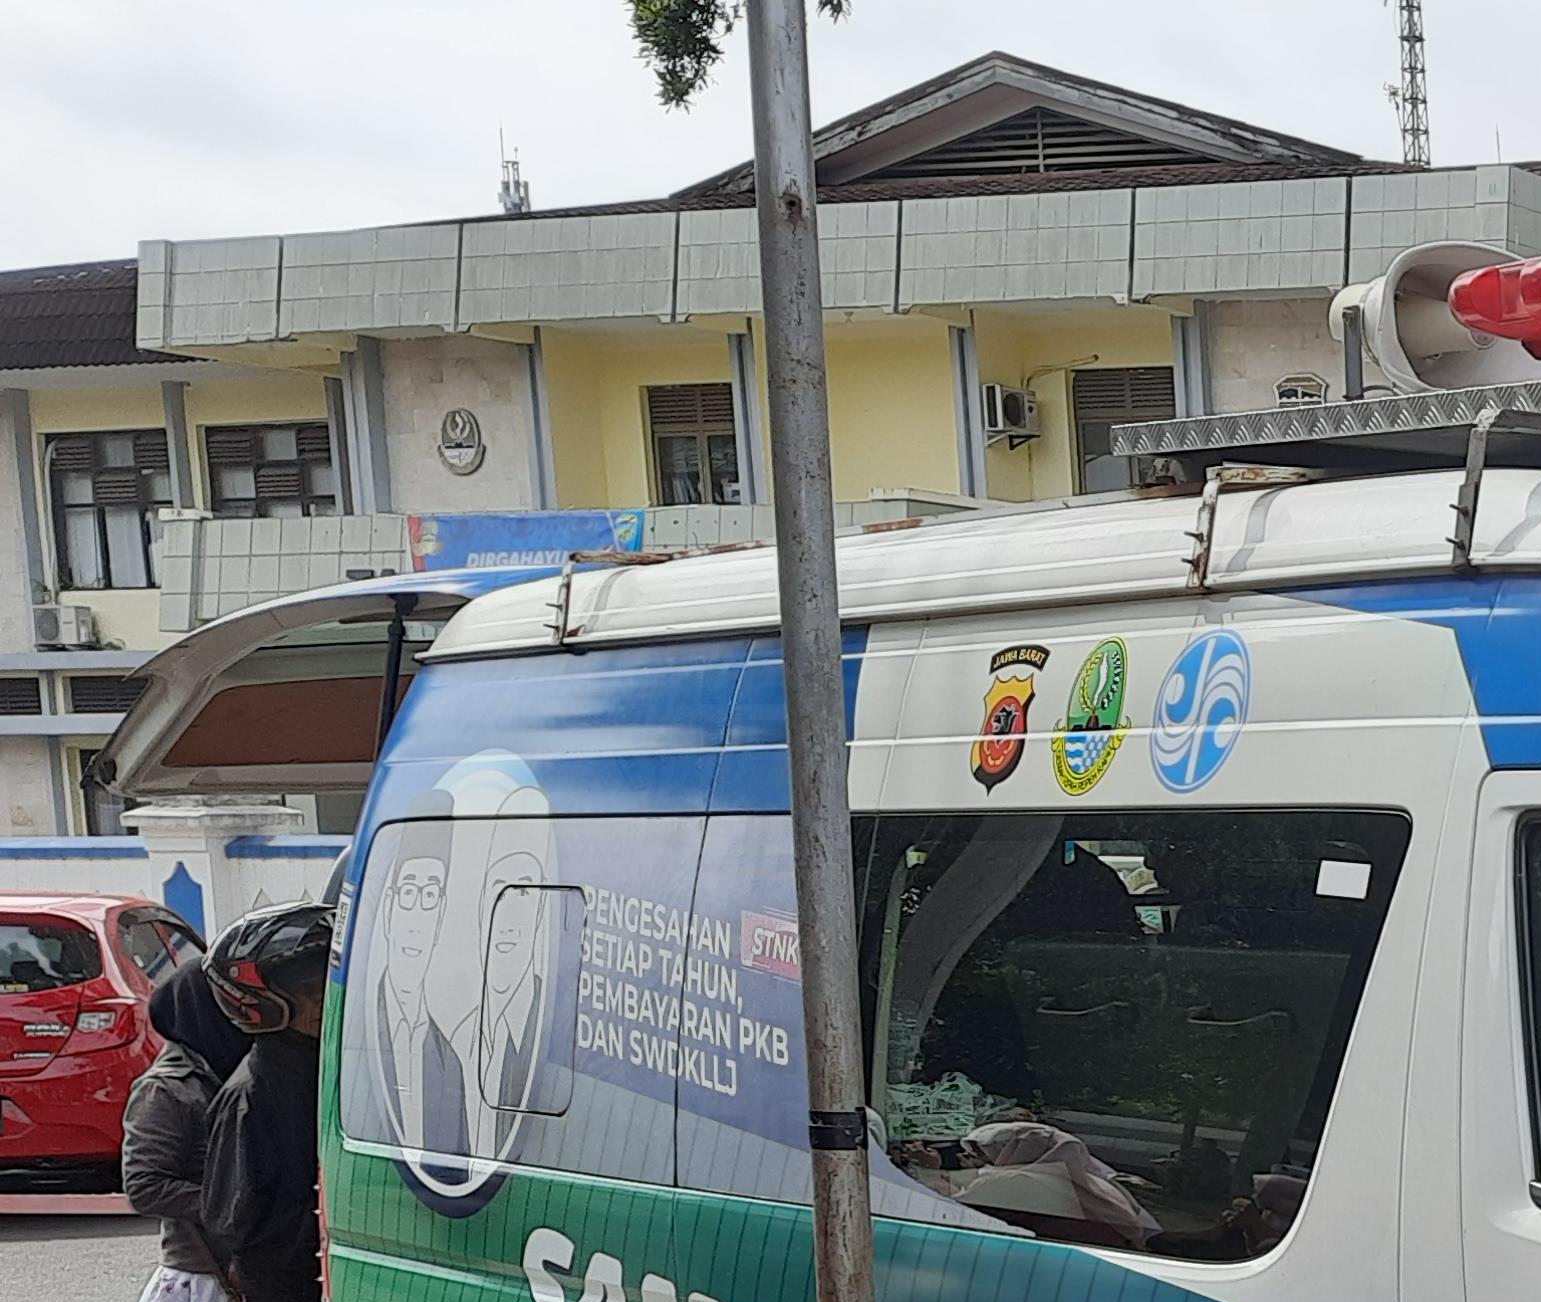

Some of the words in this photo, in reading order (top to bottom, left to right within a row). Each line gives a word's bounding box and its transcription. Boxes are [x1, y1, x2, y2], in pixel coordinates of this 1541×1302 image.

[583, 884, 731, 960] PENGESAHAN
[752, 927, 800, 965] STNK
[581, 927, 653, 978] SETIAP
[658, 948, 743, 1014] TAHUN,
[577, 1013, 624, 1061] DAN
[629, 1029, 737, 1097] SWDKLLJ
[578, 970, 732, 1050] PEMBAYARAN
[739, 1017, 790, 1066] PKB
